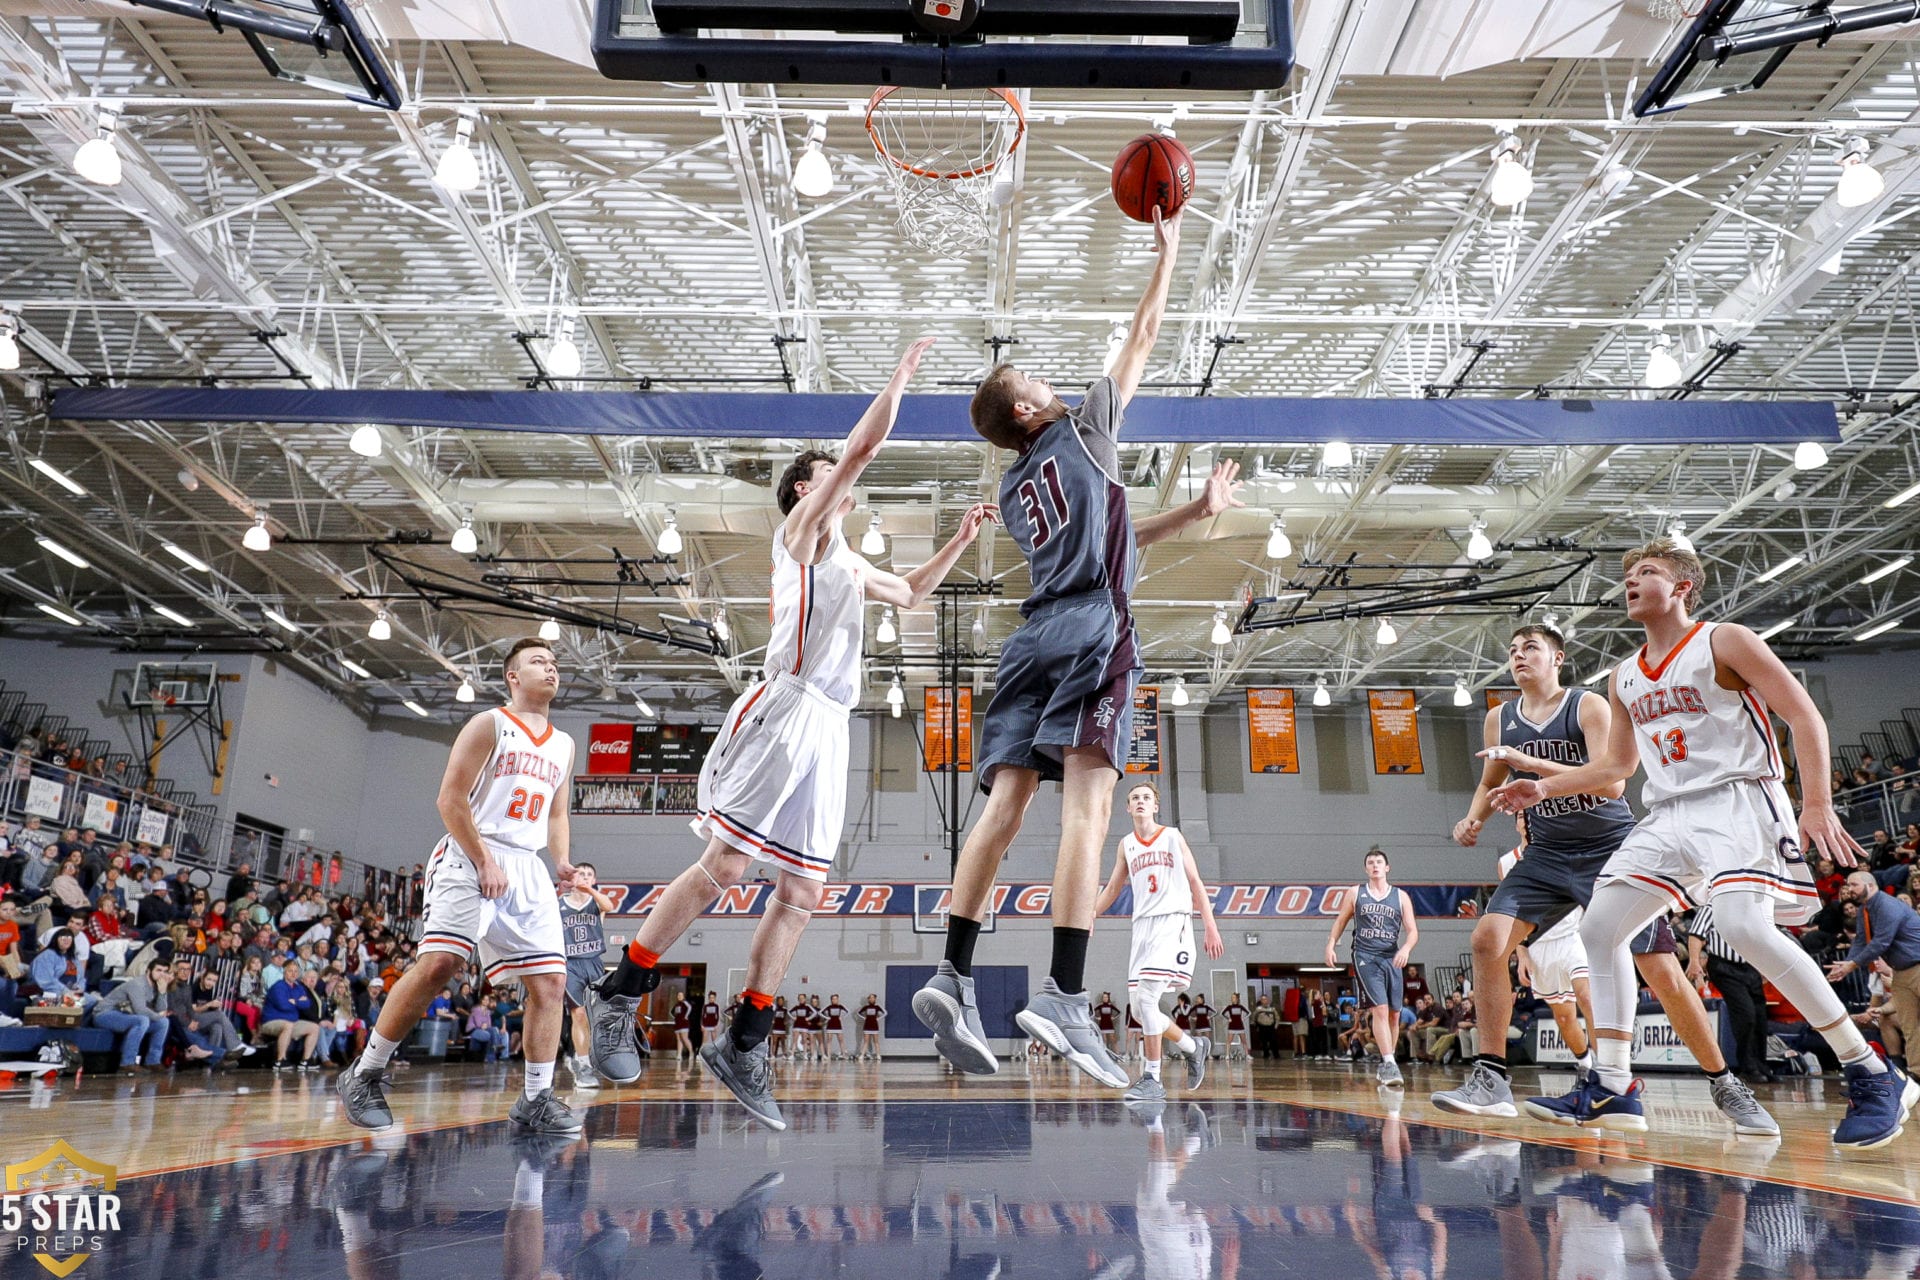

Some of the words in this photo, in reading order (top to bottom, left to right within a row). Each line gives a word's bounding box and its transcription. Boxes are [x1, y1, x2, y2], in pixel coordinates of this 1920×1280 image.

[1018, 455, 1070, 551] 31
[1513, 738, 1583, 764] OUTH
[1651, 726, 1688, 767] 13
[505, 786, 546, 824] 20
[1147, 874, 1158, 893] 3
[1360, 903, 1396, 919] SOUTH
[574, 926, 588, 943] 13
[1176, 951, 1189, 965] G
